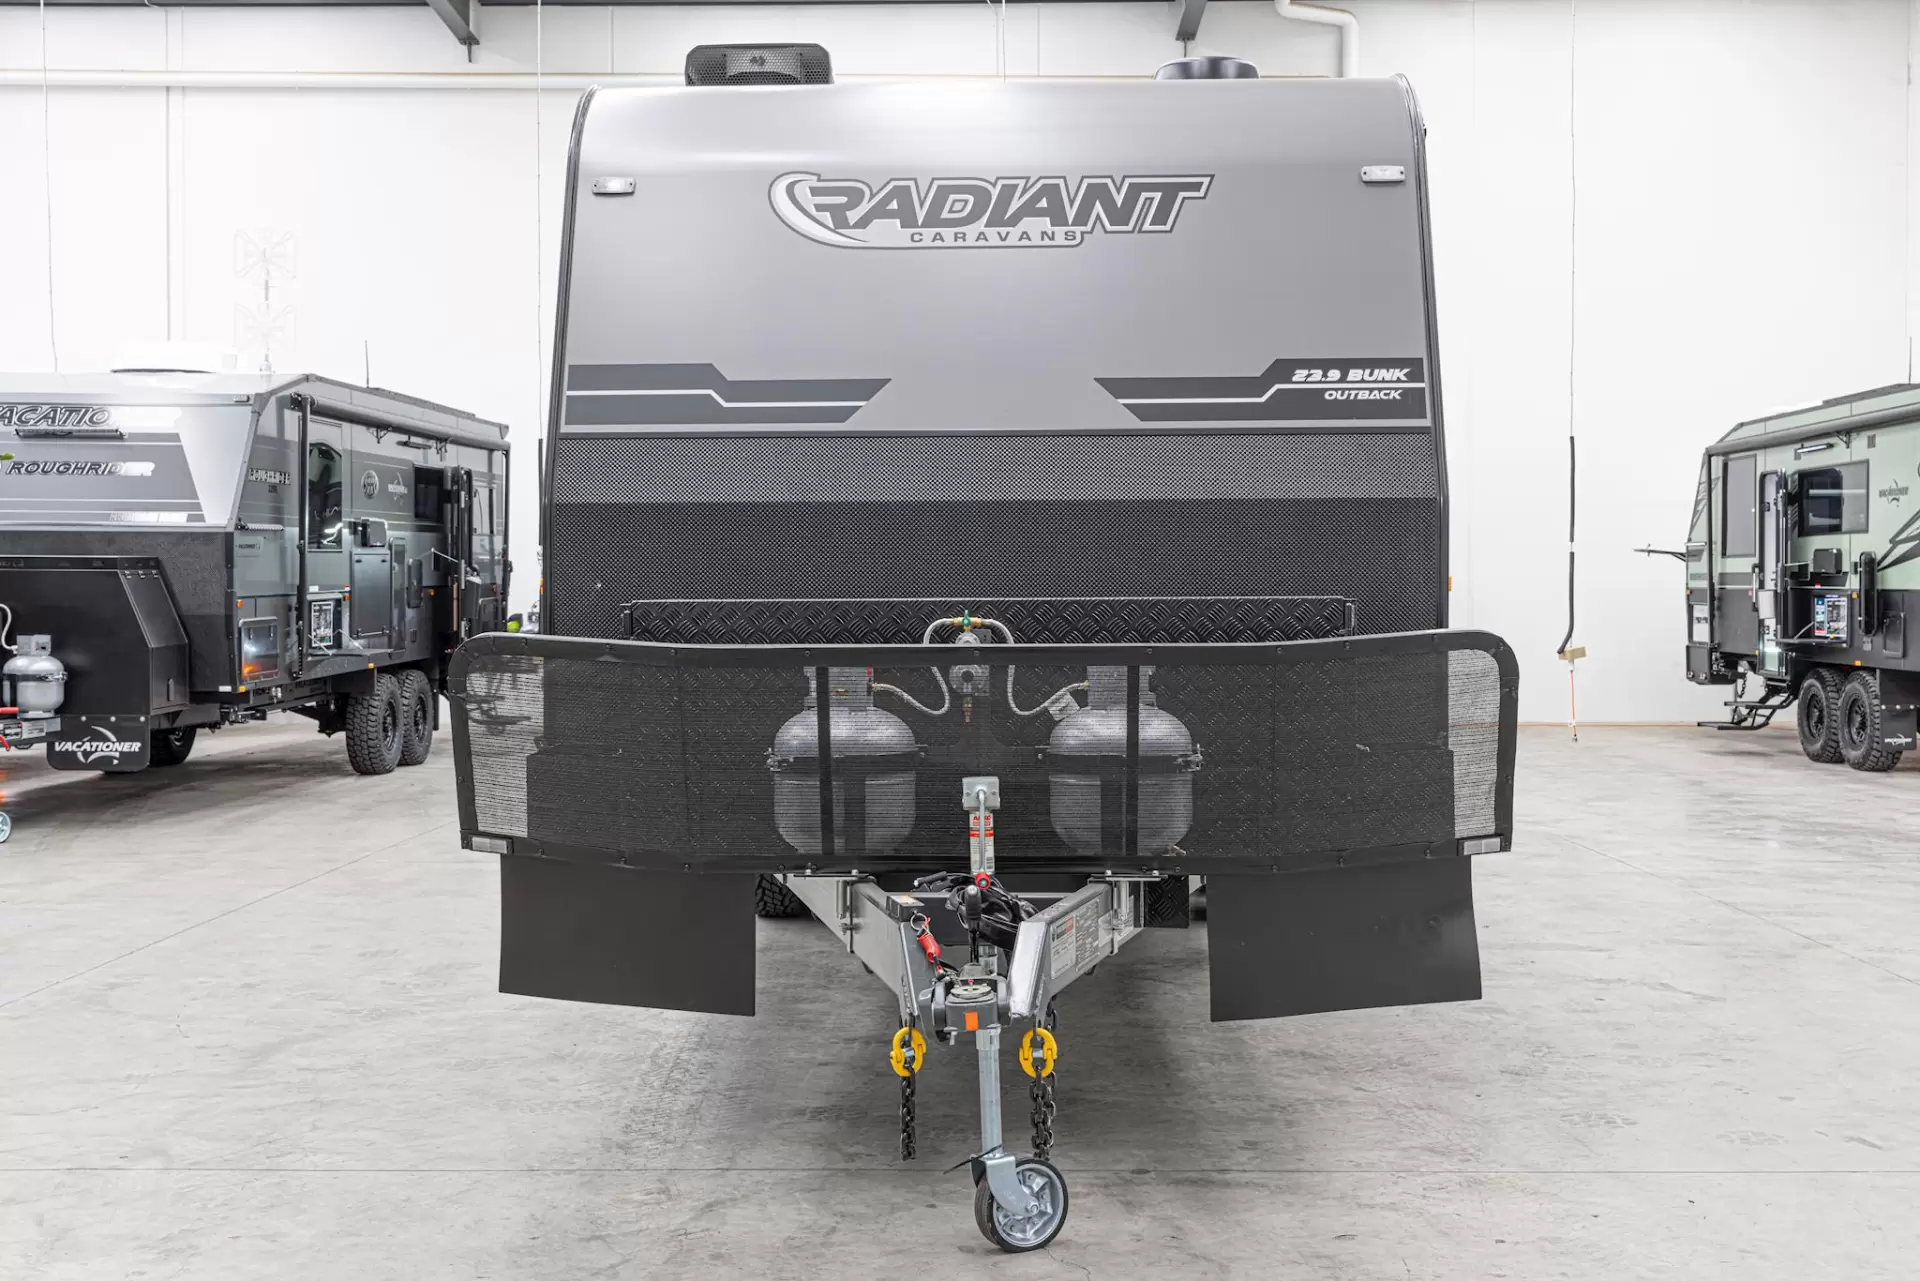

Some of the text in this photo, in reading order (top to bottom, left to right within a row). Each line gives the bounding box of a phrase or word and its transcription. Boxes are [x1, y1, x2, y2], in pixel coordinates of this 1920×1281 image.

[784, 174, 1214, 234] RADIANT
[909, 230, 1077, 244] CARAVANS
[1291, 367, 1412, 382] 23.9 BUNK
[1323, 389, 1403, 400] OUTBACK
[6, 460, 155, 477] ROUGHRID
[54, 740, 142, 752] VACATIONER
